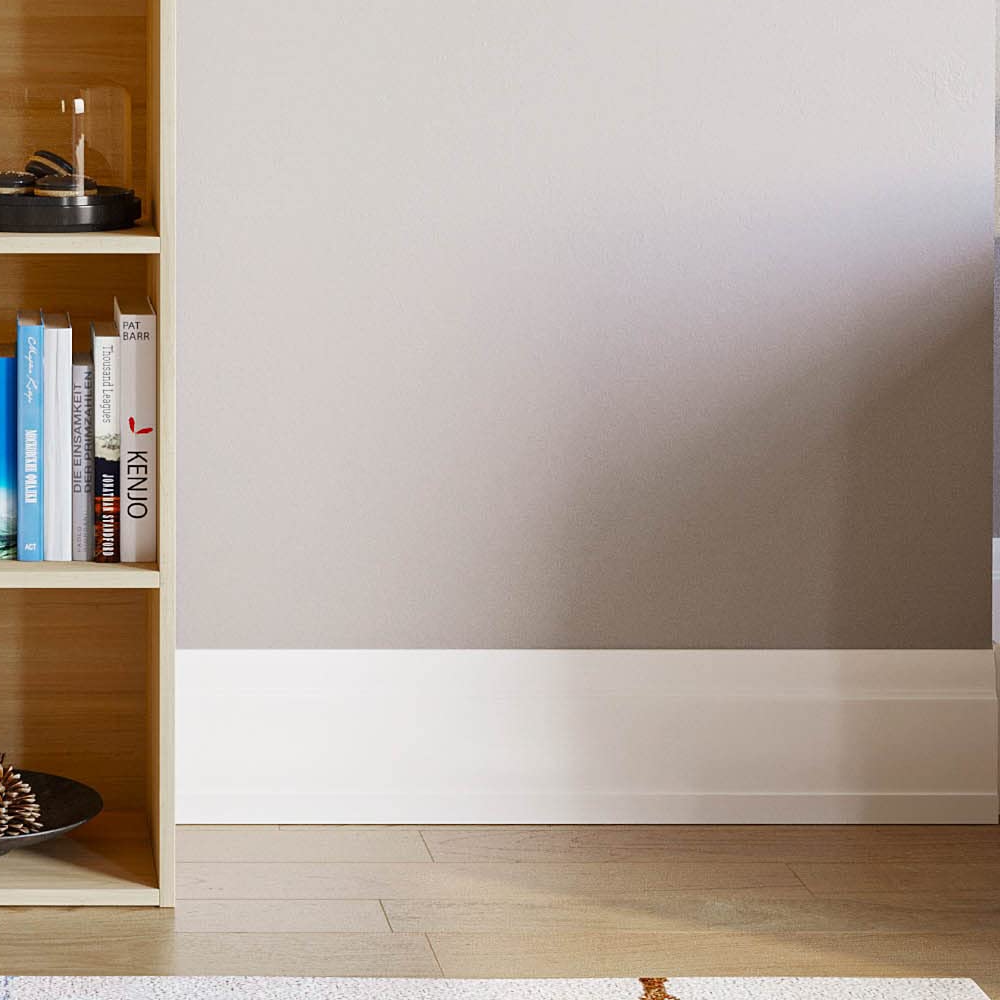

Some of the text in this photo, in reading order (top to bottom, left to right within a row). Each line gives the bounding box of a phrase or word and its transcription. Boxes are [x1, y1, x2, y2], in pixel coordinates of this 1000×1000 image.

[122, 321, 141, 330] PAT
[122, 331, 150, 341] BARR
[102, 345, 114, 424] Thousand Leagues
[73, 384, 82, 494] DIE EINSAMKEIT
[83, 371, 93, 494] DER PRIMZAHLEN
[102, 474, 115, 557] JONATHAN STANDFORD
[127, 451, 148, 519] KENJO
